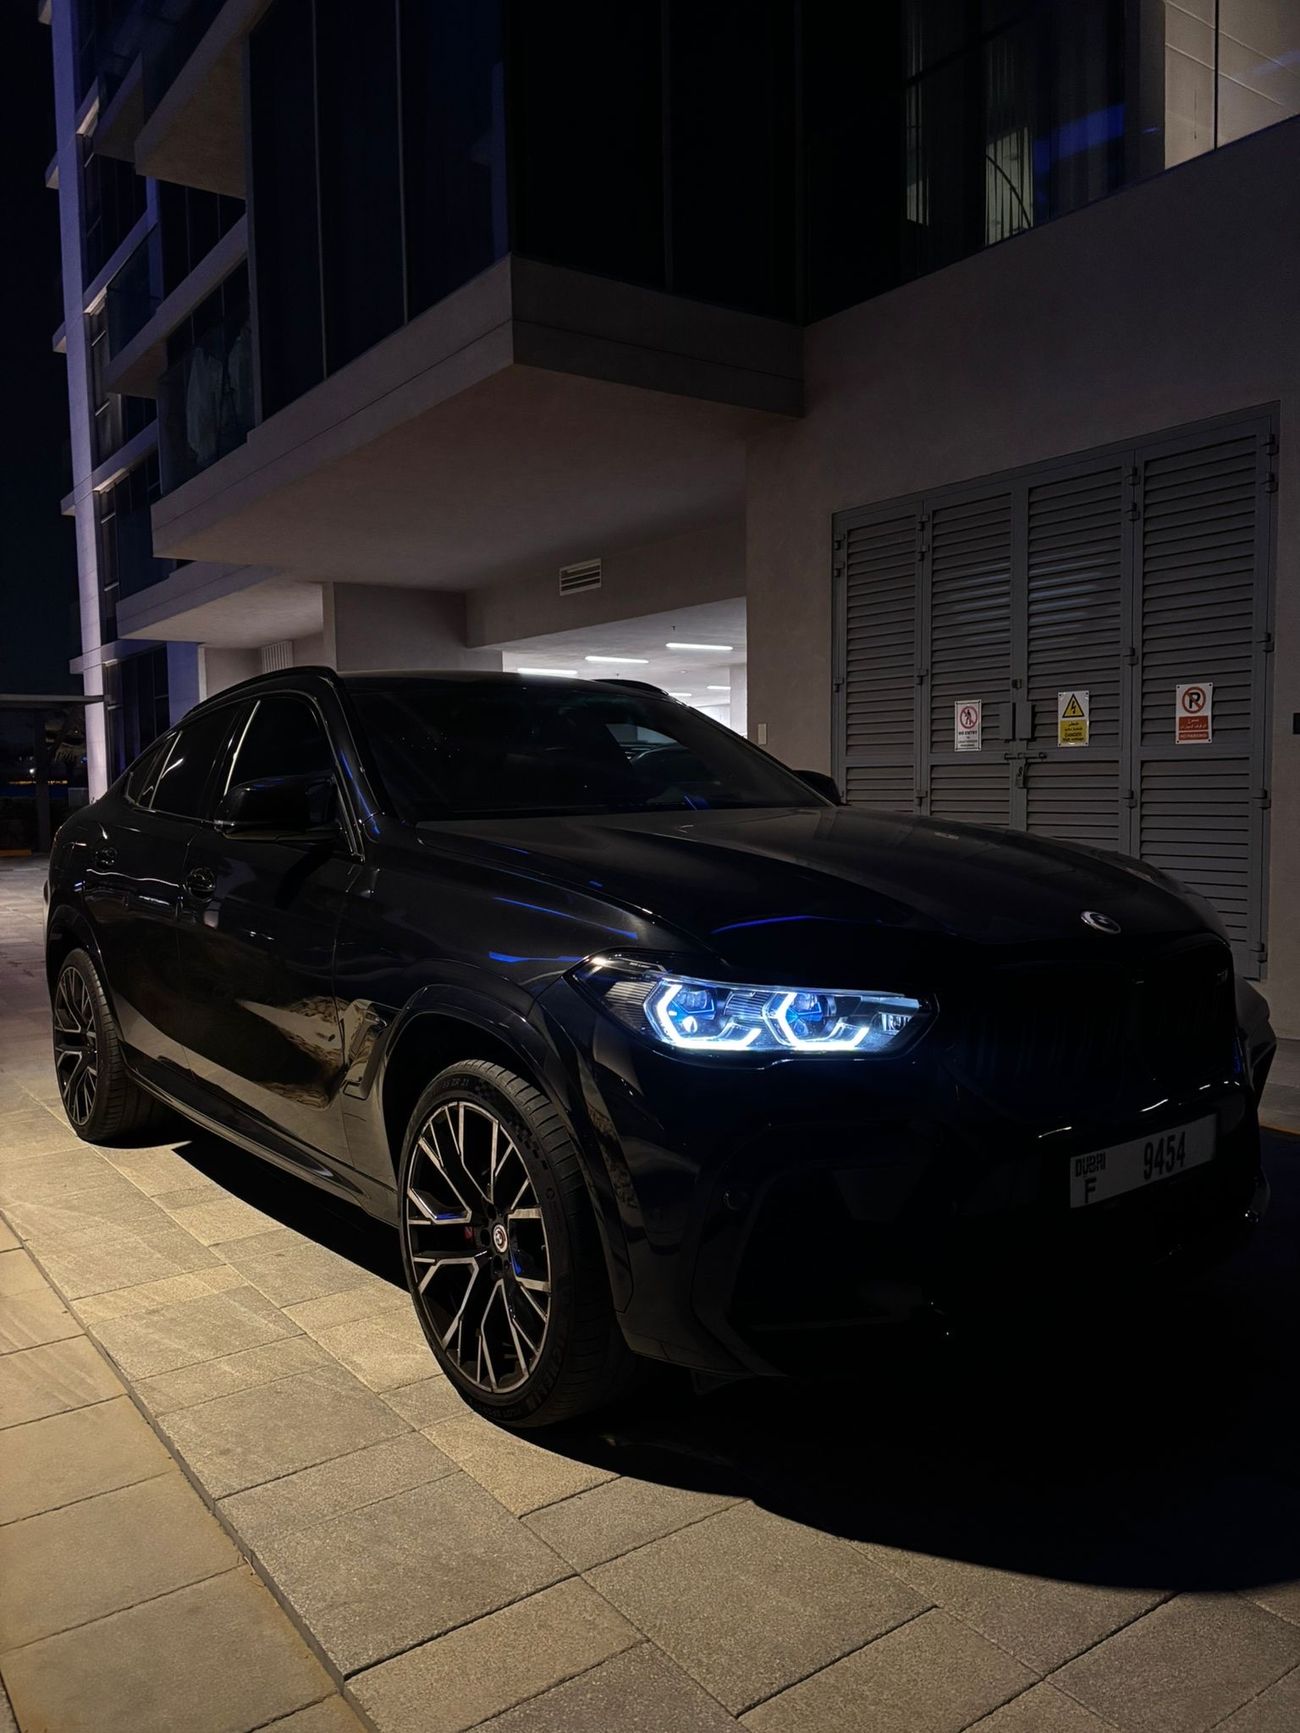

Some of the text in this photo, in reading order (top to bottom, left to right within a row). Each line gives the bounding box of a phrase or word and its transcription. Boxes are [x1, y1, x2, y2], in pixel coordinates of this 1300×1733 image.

[1075, 1131, 1186, 1180] DUBAI 9454
[1085, 1177, 1097, 1204] F
